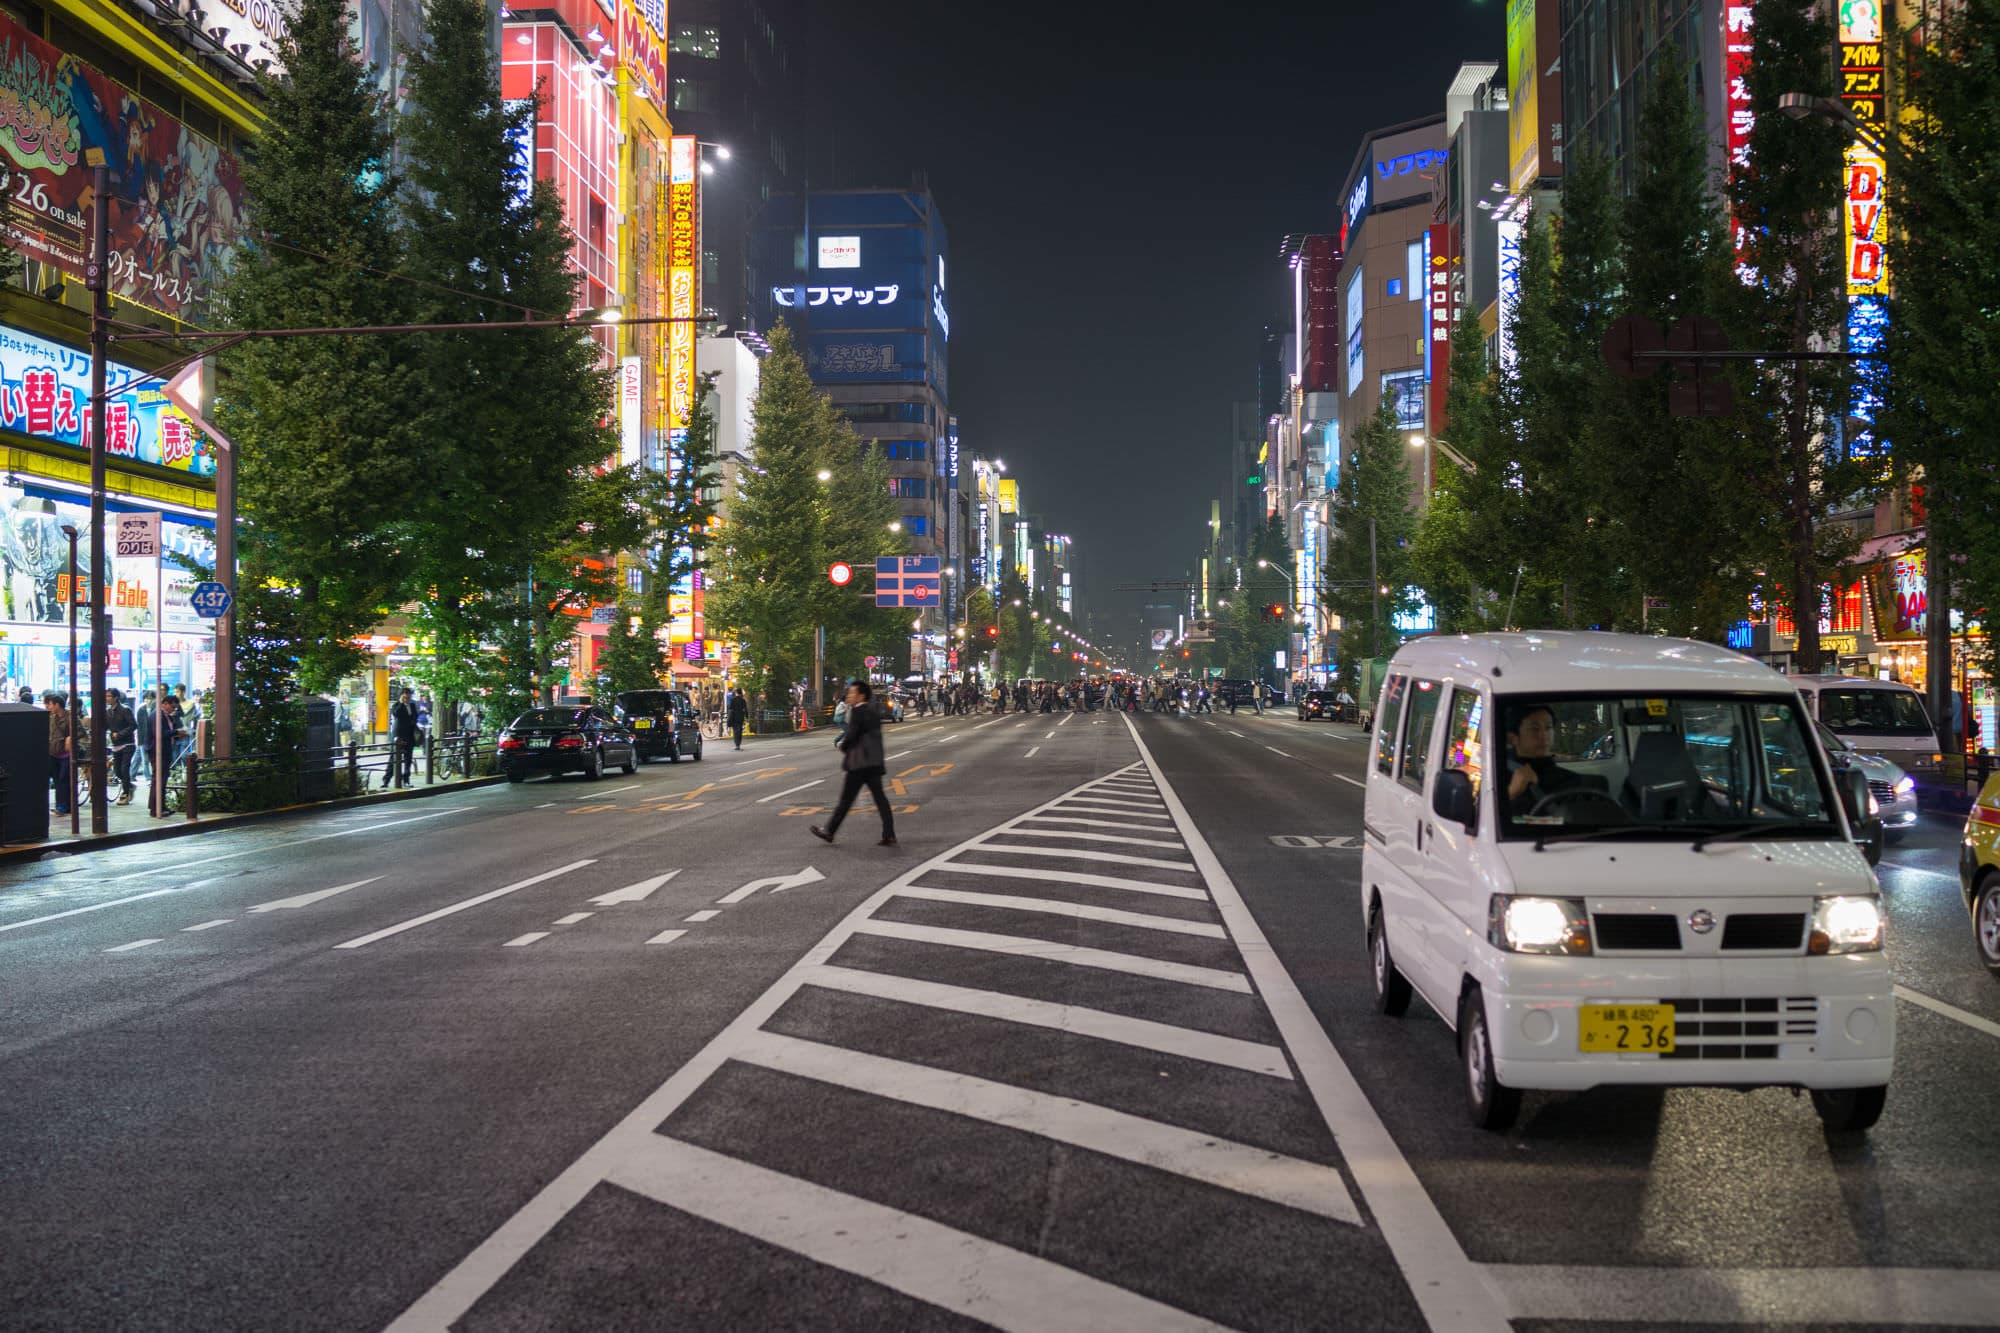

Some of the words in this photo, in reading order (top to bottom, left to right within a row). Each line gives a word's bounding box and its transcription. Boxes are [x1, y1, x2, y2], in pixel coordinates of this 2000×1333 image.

[1843, 45, 1881, 66] アイドル
[1844, 73, 1881, 92] アニメ
[66, 211, 87, 230] sale
[1849, 164, 1884, 281] DVD
[120, 530, 152, 541] タクシー
[118, 542, 153, 554] のりば
[117, 579, 148, 608] Sale
[194, 592, 226, 607] 437
